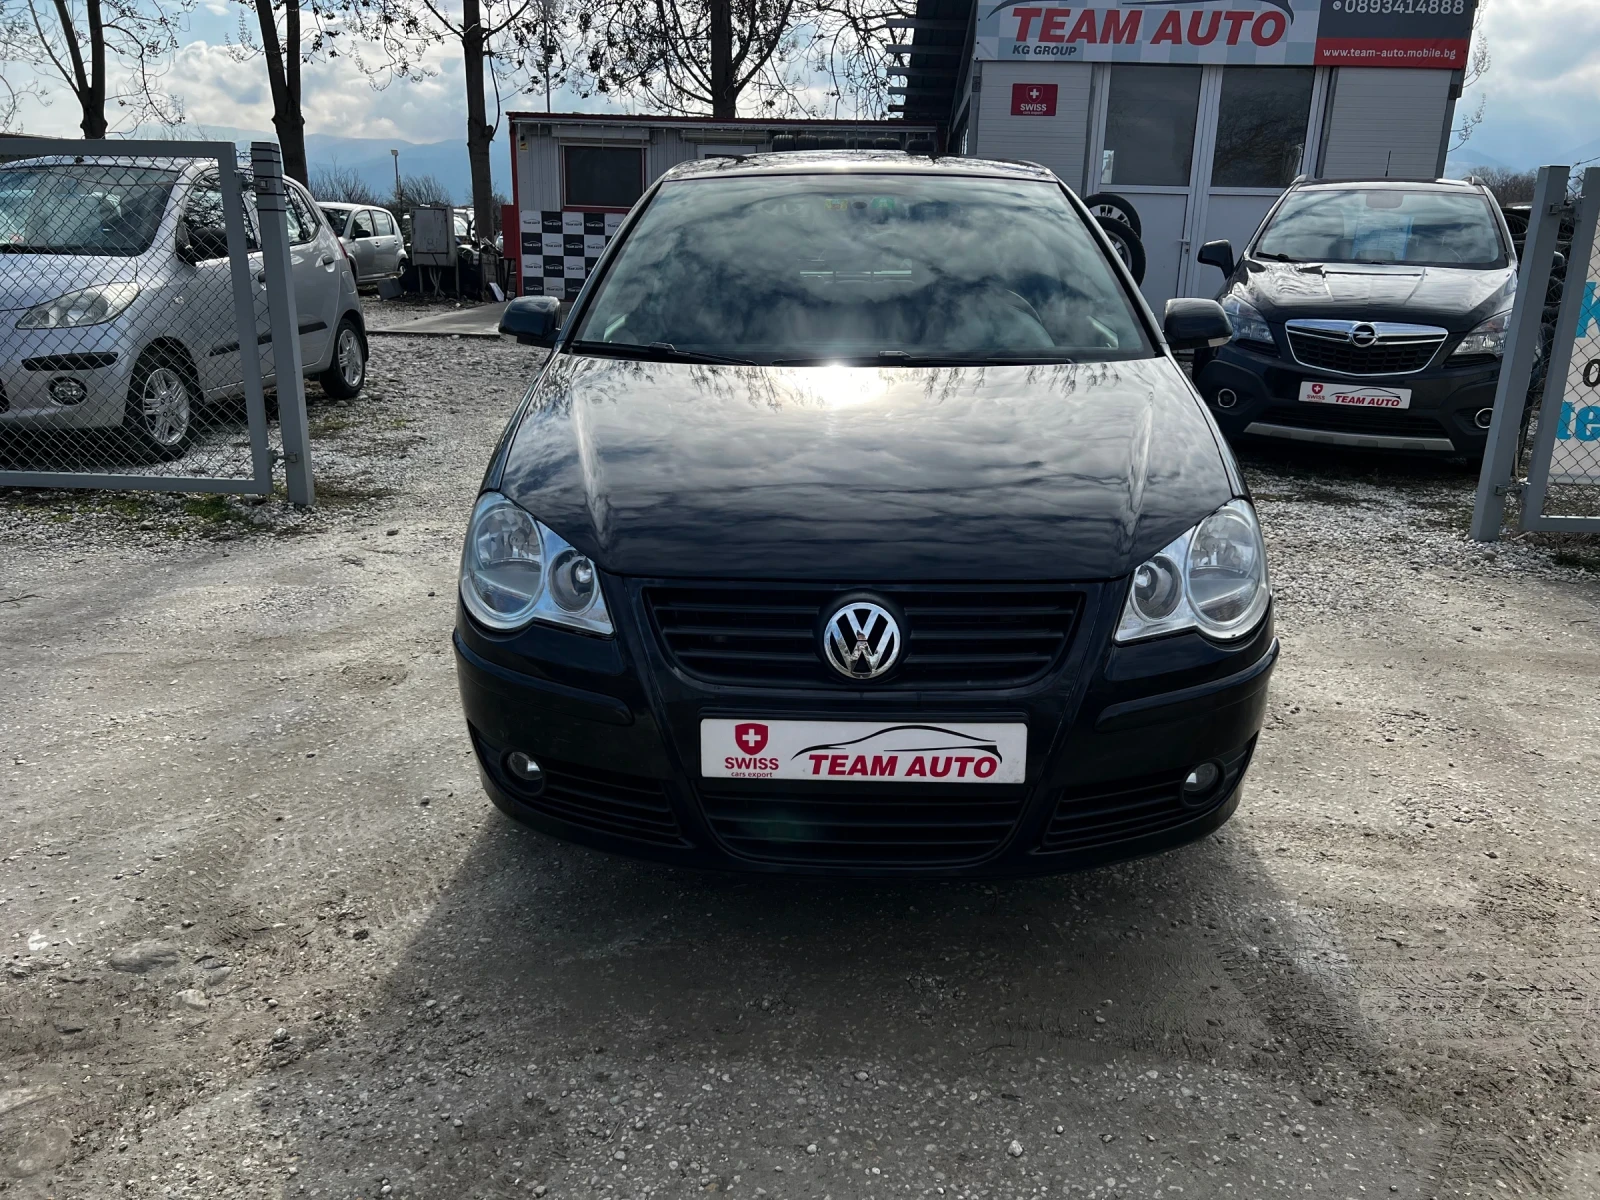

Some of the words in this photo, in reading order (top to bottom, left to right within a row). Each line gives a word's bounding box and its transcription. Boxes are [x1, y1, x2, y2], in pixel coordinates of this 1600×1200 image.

[1344, 0, 1465, 14] 0893414888
[1012, 7, 1143, 45] TEAM
[1150, 10, 1287, 47] AUTO
[1012, 44, 1031, 55] KG
[1033, 45, 1078, 56] GROUP
[1323, 47, 1456, 60] www.team-auto.mobile.bg
[1020, 103, 1047, 112] SWISS
[1335, 395, 1365, 405] TEAM
[1368, 397, 1400, 407] AUTO
[724, 756, 780, 771] SWISS
[808, 753, 899, 777] TEAM
[904, 755, 998, 779] AUTO
